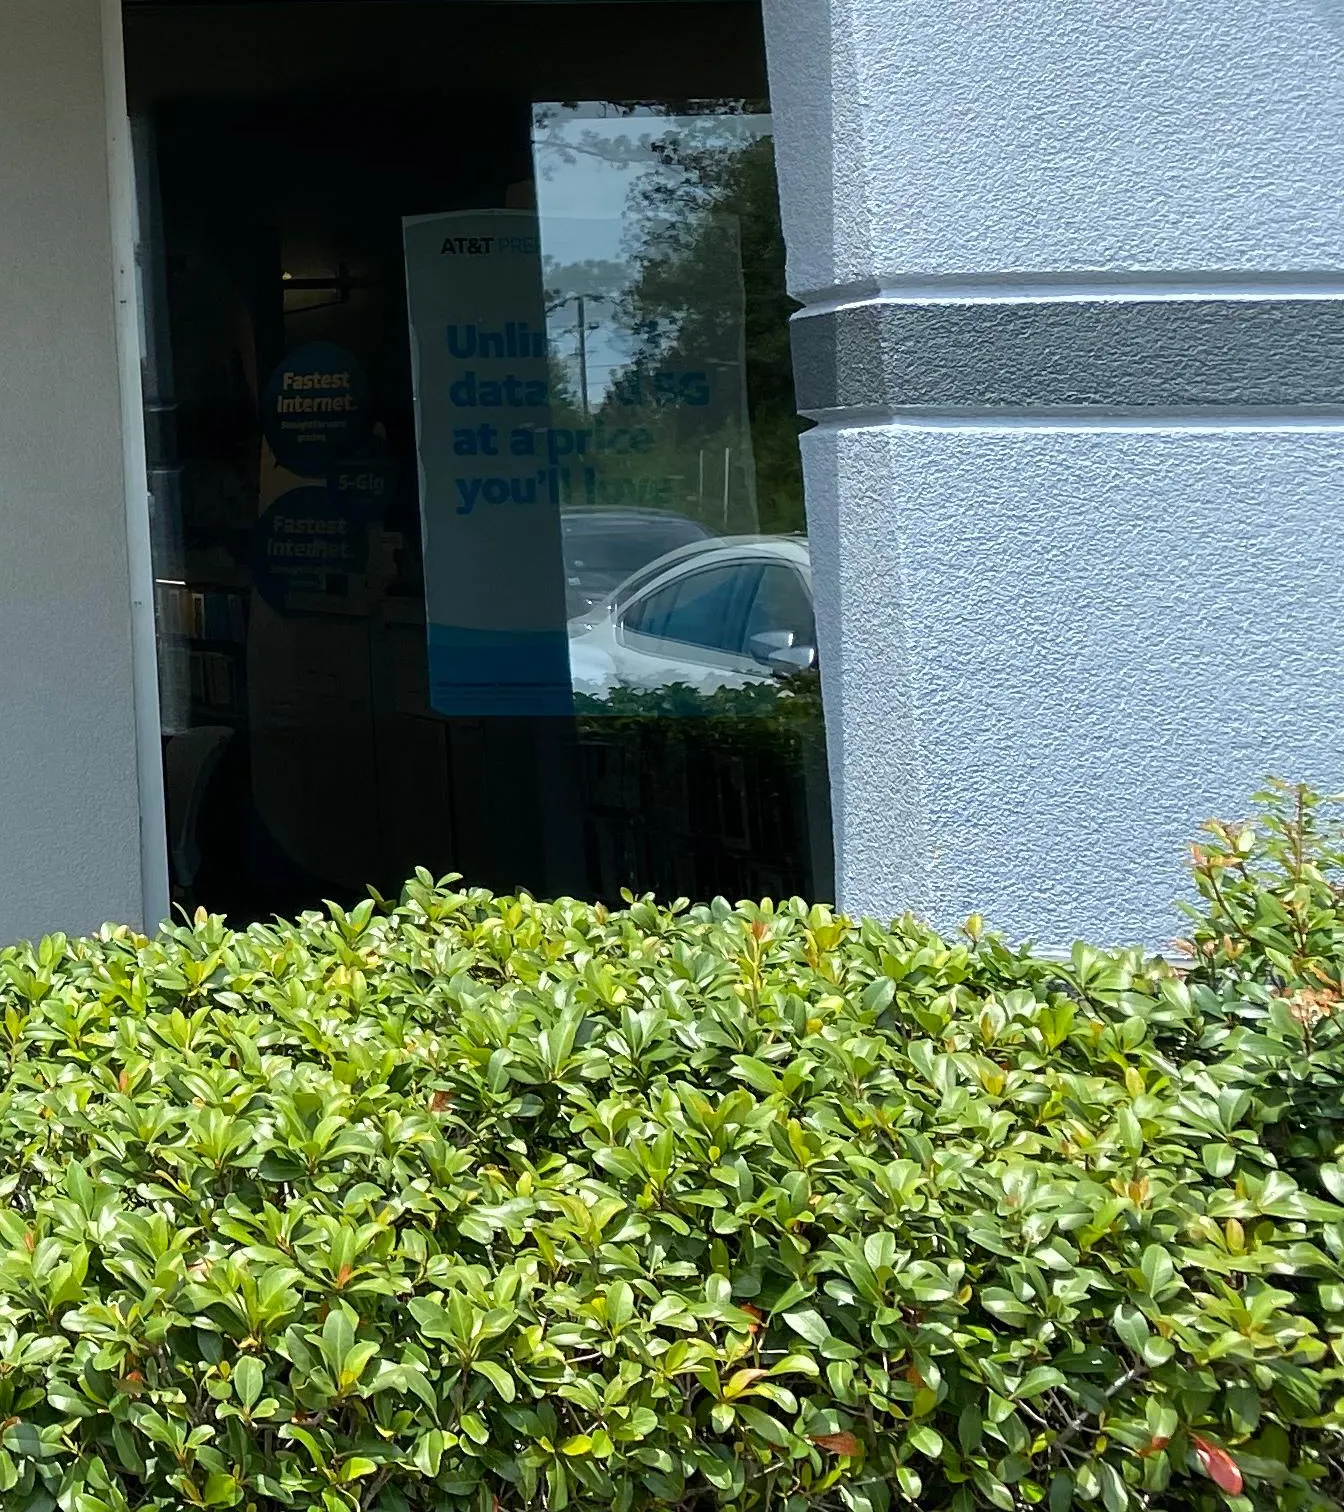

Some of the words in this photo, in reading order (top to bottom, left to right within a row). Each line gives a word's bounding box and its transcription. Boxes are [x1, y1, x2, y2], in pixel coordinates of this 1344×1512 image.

[440, 237, 494, 255] AT&T
[499, 238, 540, 255] PRE
[282, 370, 351, 391] Fastest
[448, 371, 550, 407] data
[276, 394, 359, 414] Internet.
[452, 423, 499, 457] at
[509, 428, 535, 457] a
